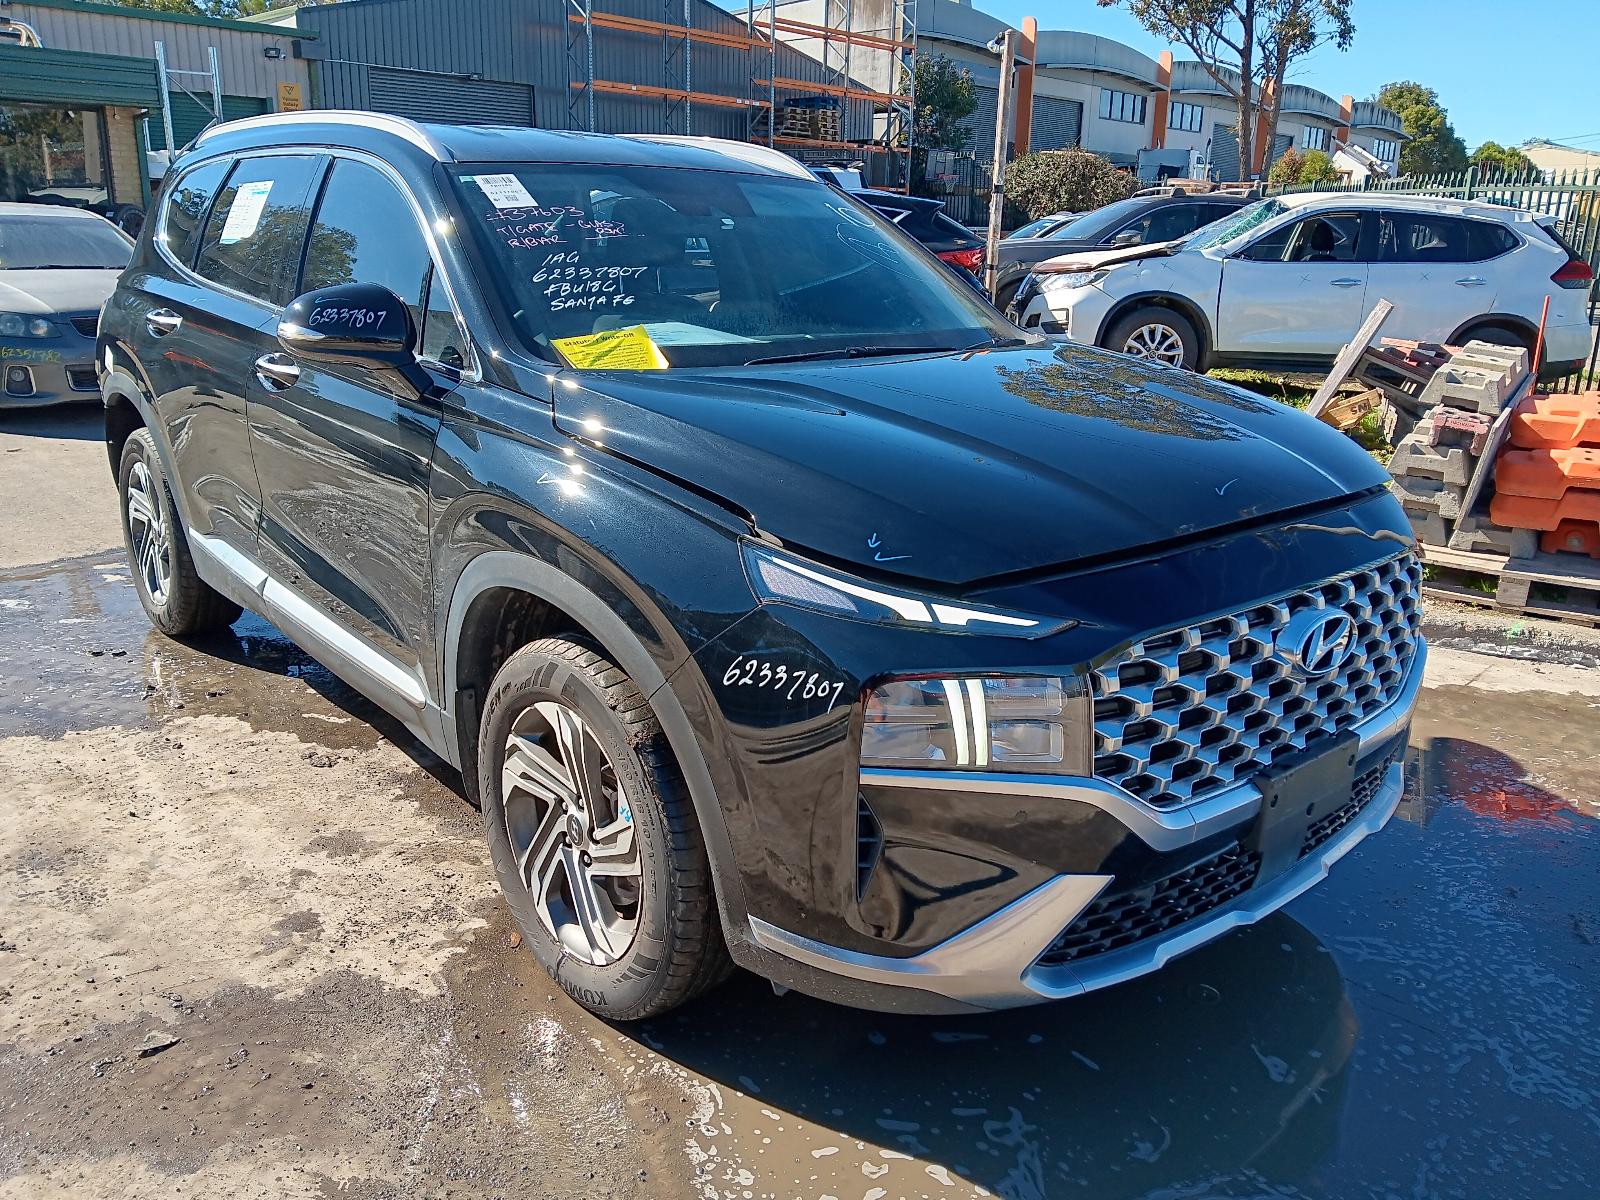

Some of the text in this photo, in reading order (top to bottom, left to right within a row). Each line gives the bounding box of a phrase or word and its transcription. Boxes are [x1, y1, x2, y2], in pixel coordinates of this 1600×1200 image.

[532, 266, 648, 283] 62337807
[543, 280, 617, 297] FBU18G
[550, 296, 607, 311] SANTA
[308, 307, 387, 331] 62337807
[722, 655, 845, 715] 62337807
